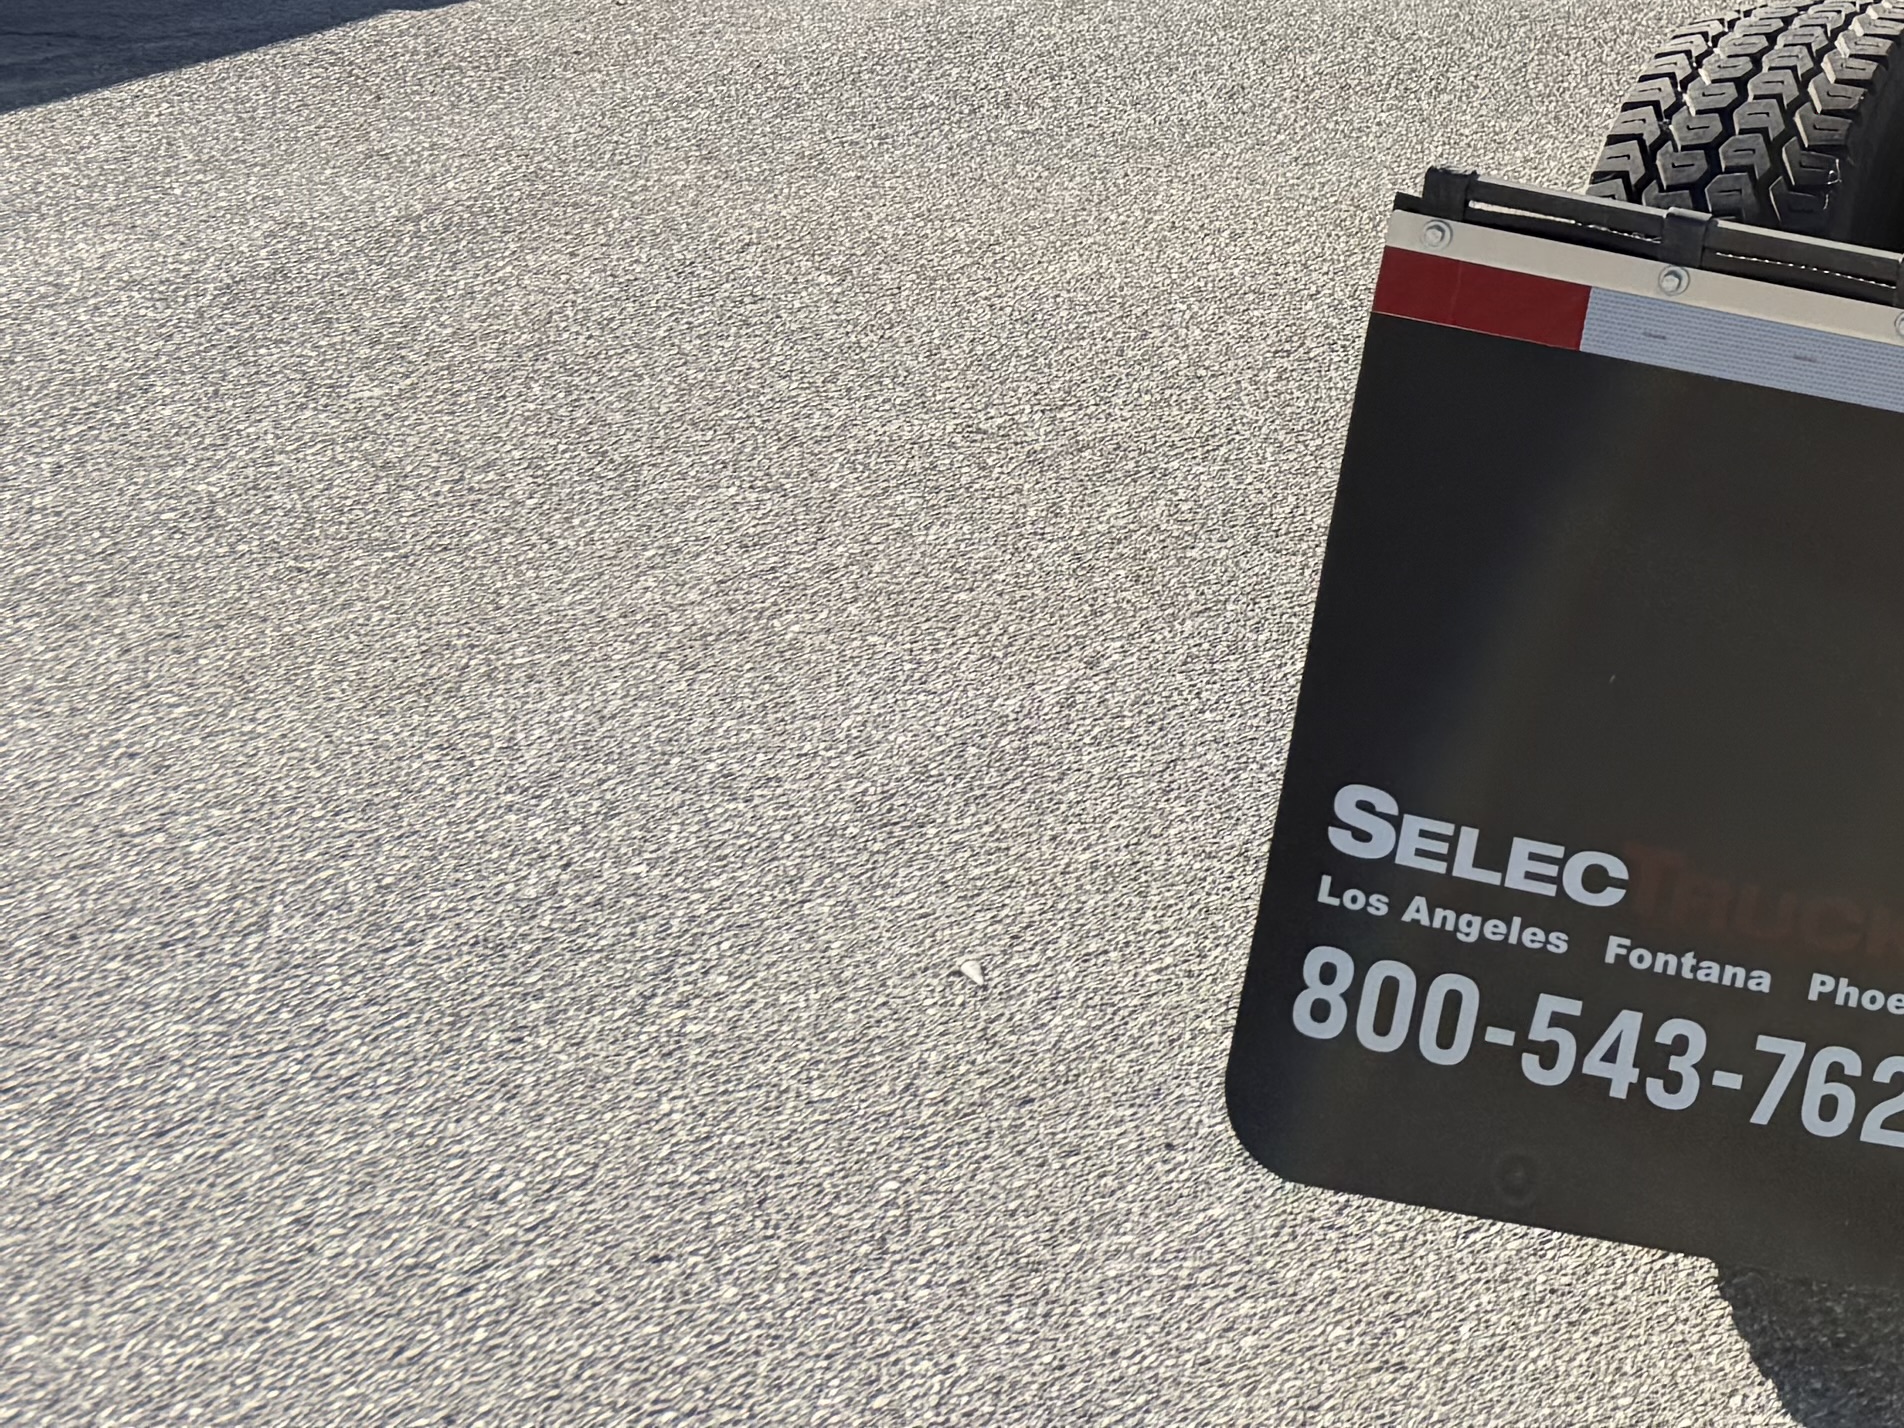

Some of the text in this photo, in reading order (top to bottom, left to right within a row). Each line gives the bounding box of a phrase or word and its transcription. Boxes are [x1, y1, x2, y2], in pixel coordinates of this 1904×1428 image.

[1317, 874, 1389, 917] Los
[1402, 895, 1571, 955] Angeles
[1604, 935, 1773, 994] Fontana
